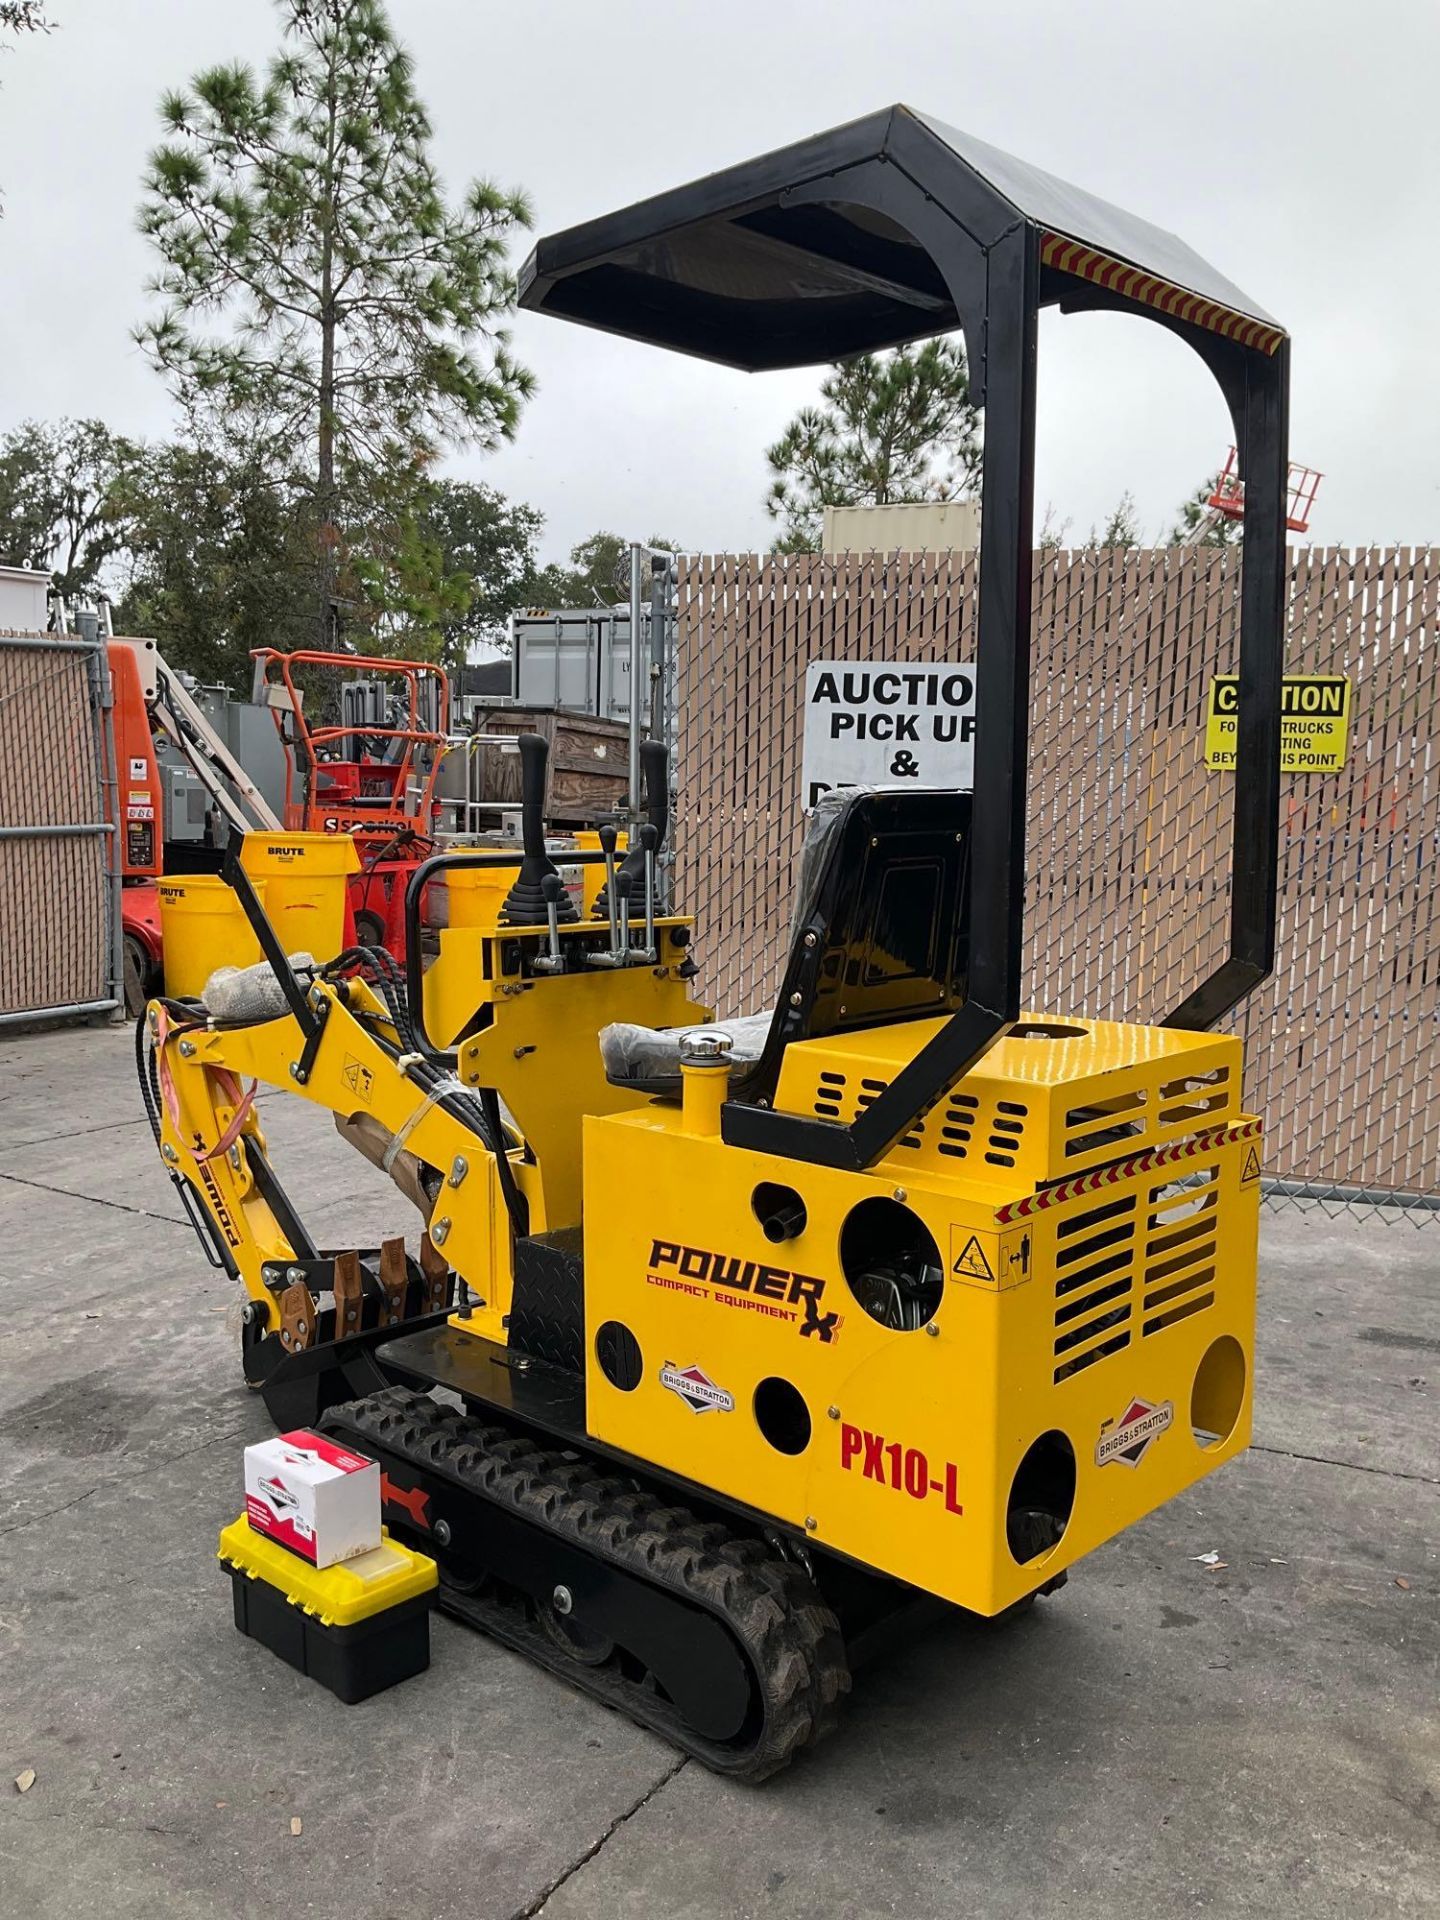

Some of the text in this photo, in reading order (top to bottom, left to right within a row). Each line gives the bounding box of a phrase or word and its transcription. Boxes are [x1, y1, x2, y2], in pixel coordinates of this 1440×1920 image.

[811, 672, 974, 706] AUCTIO
[1218, 685, 1341, 711] CTION
[830, 712, 921, 742] PICK
[1282, 722, 1333, 734] TRUCKS
[889, 749, 920, 778] &
[1212, 752, 1237, 763] BEY
[1298, 753, 1337, 766] POINT
[267, 846, 306, 856] BRUTE
[159, 886, 186, 898] BRUTE
[646, 1273, 798, 1323] COMPACT EQUIPMENT
[841, 1421, 963, 1517] PX10-L
